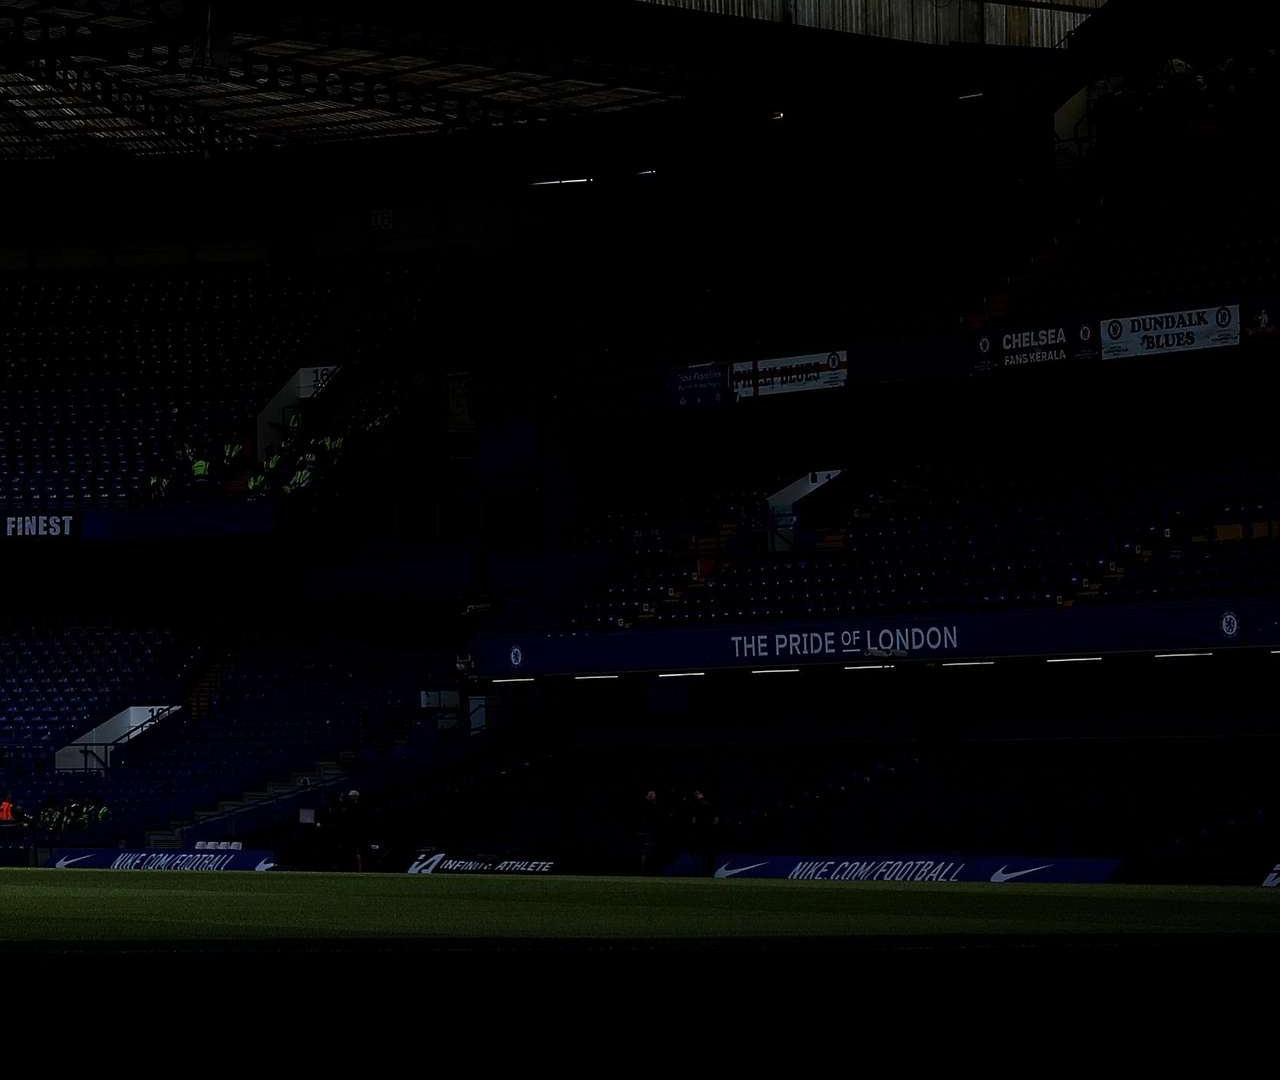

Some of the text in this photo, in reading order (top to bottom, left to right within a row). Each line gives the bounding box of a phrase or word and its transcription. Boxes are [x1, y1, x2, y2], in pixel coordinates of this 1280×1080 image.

[1130, 310, 1208, 333] DUNDALK
[1002, 328, 1067, 351] CHELSEA
[1143, 331, 1195, 350] BLUES
[1004, 351, 1028, 367] FANS
[1029, 348, 1067, 364] KERALA
[6, 515, 73, 537] FINEST
[731, 626, 959, 657] THE PRIDE OF LONDON
[494, 861, 554, 872] ATHLETE
[788, 861, 965, 882] NIKE.COM/FOOTBALL
